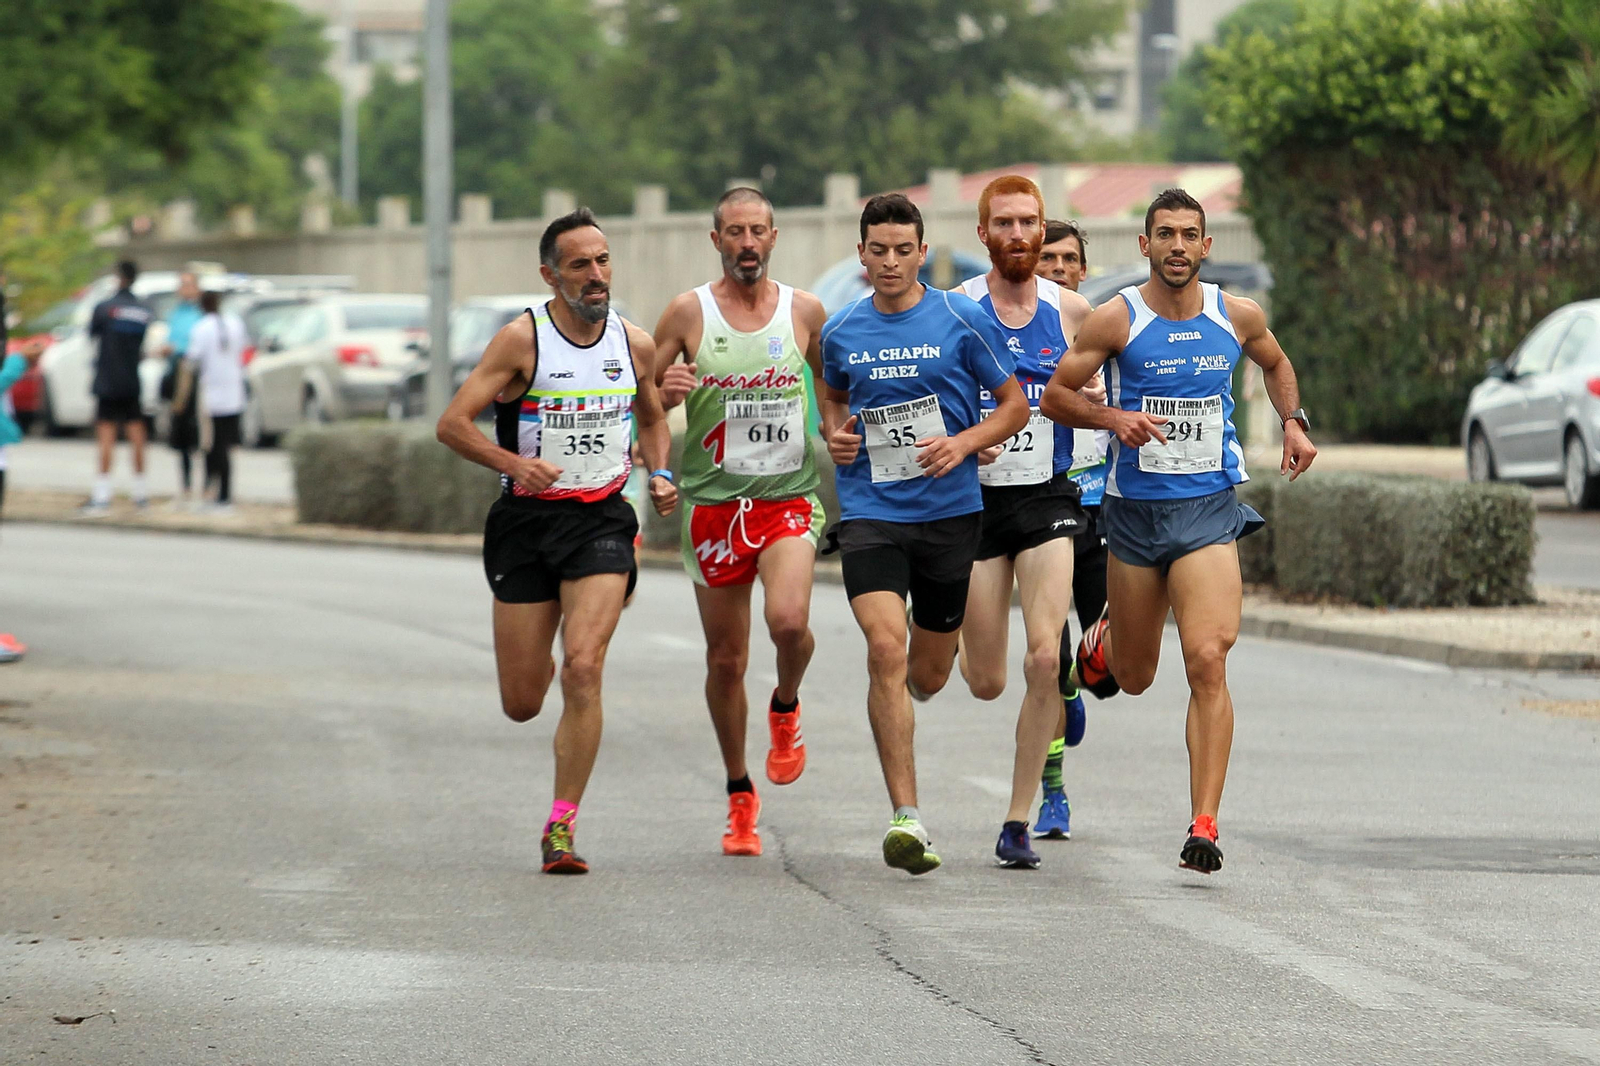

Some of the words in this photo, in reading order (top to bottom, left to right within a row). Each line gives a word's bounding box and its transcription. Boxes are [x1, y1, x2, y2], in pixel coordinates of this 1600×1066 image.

[1168, 331, 1202, 343] Joma
[848, 351, 876, 364] C.A.
[879, 344, 941, 361] CHAPÍN
[1144, 361, 1158, 369] C.A.
[1160, 357, 1187, 366] CHAPÍN
[1192, 354, 1228, 368] MANUEL
[702, 366, 798, 389] maratón
[869, 365, 919, 380] JEREZ
[1156, 367, 1177, 375] JEREZ
[1145, 399, 1176, 416] XXXIX
[1178, 400, 1202, 409] CARRERA
[748, 422, 790, 443] 616
[887, 425, 917, 448] 35
[1165, 421, 1203, 442] 291
[563, 433, 605, 456] 355
